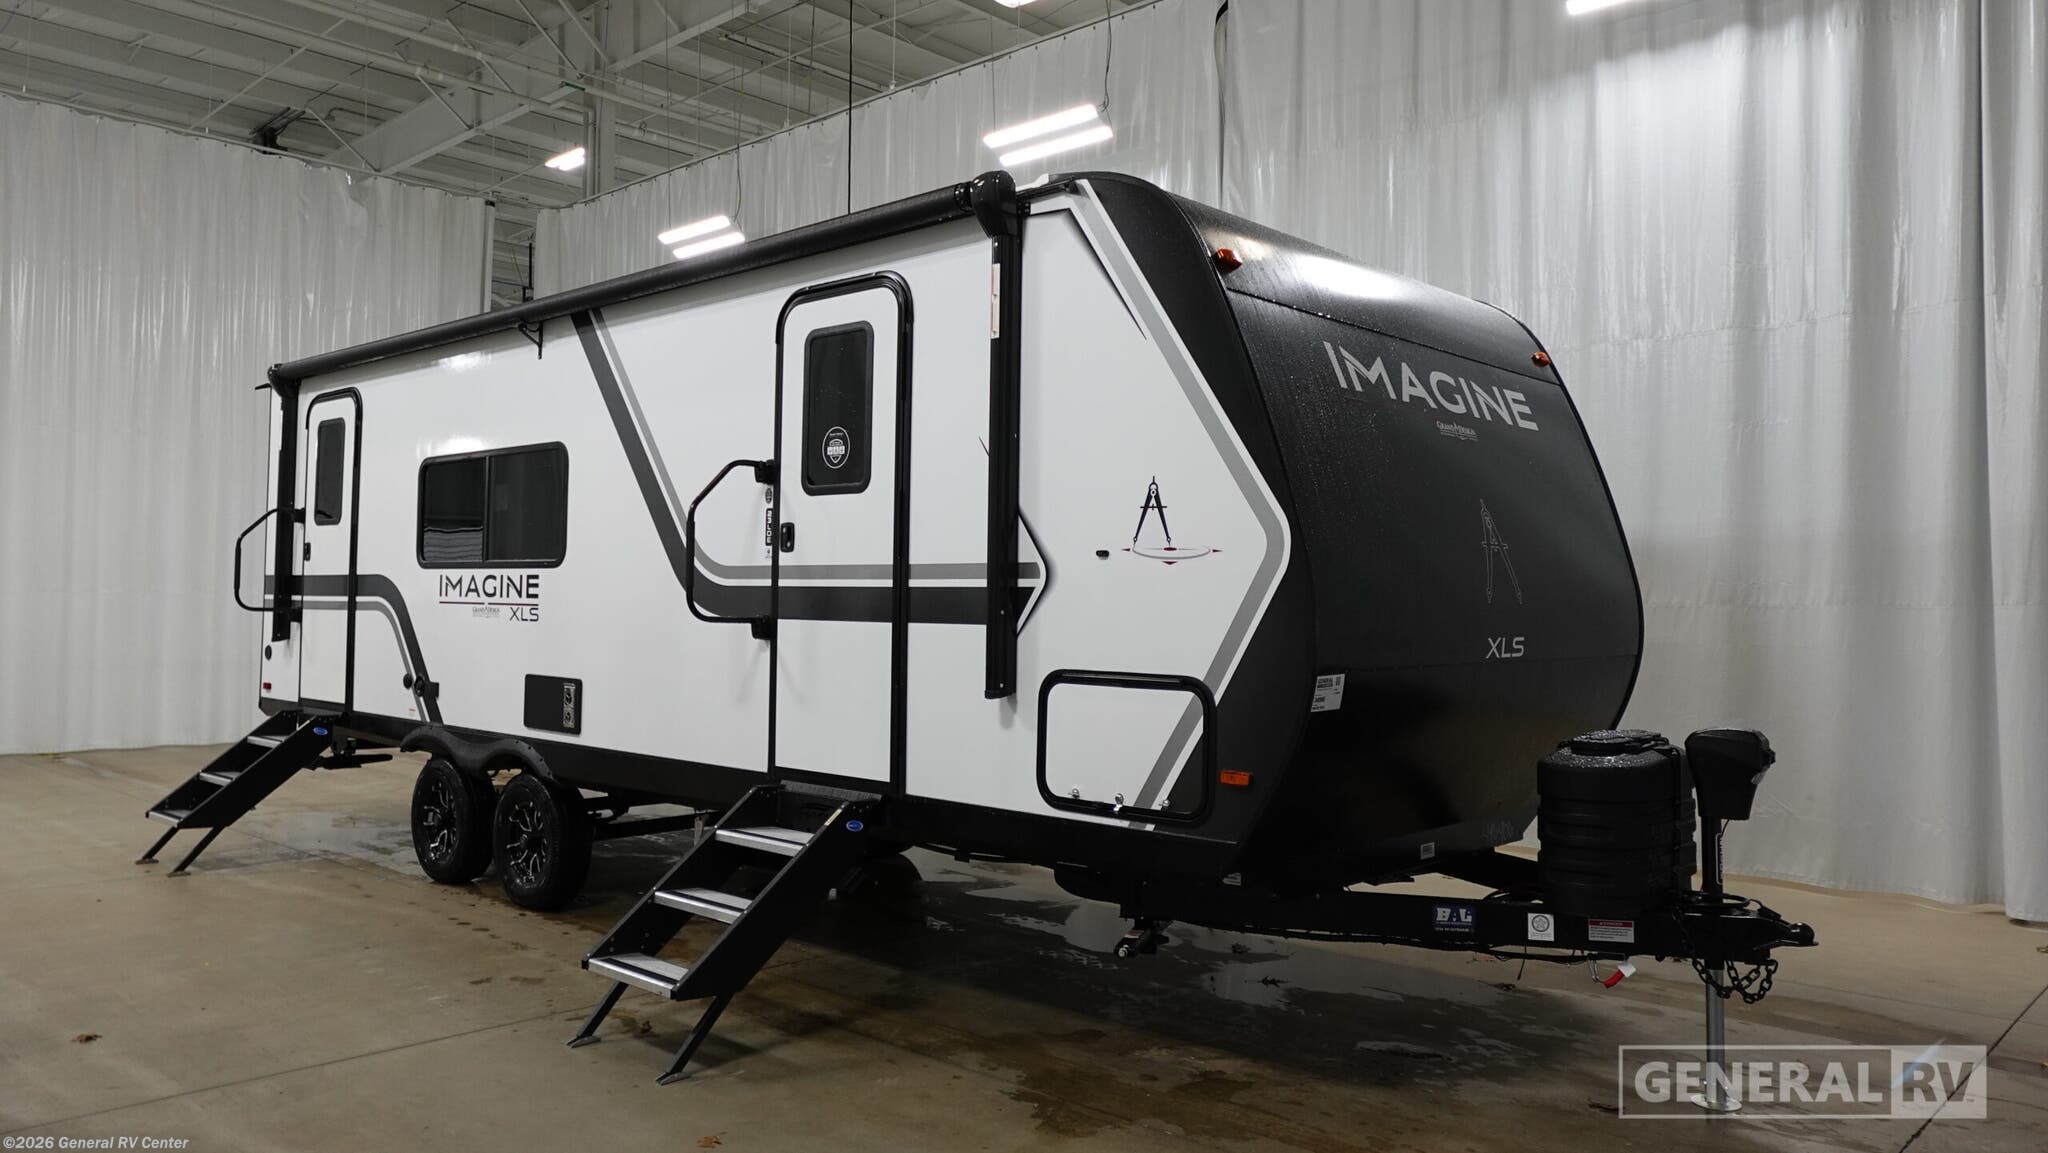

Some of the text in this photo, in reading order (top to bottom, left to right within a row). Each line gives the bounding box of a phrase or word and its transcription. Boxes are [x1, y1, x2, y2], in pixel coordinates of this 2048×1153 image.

[1322, 340, 1539, 431] IMAGINE
[439, 574, 539, 598] IMAGINE
[510, 607, 539, 621] XLS
[1486, 636, 1525, 659] XLS
